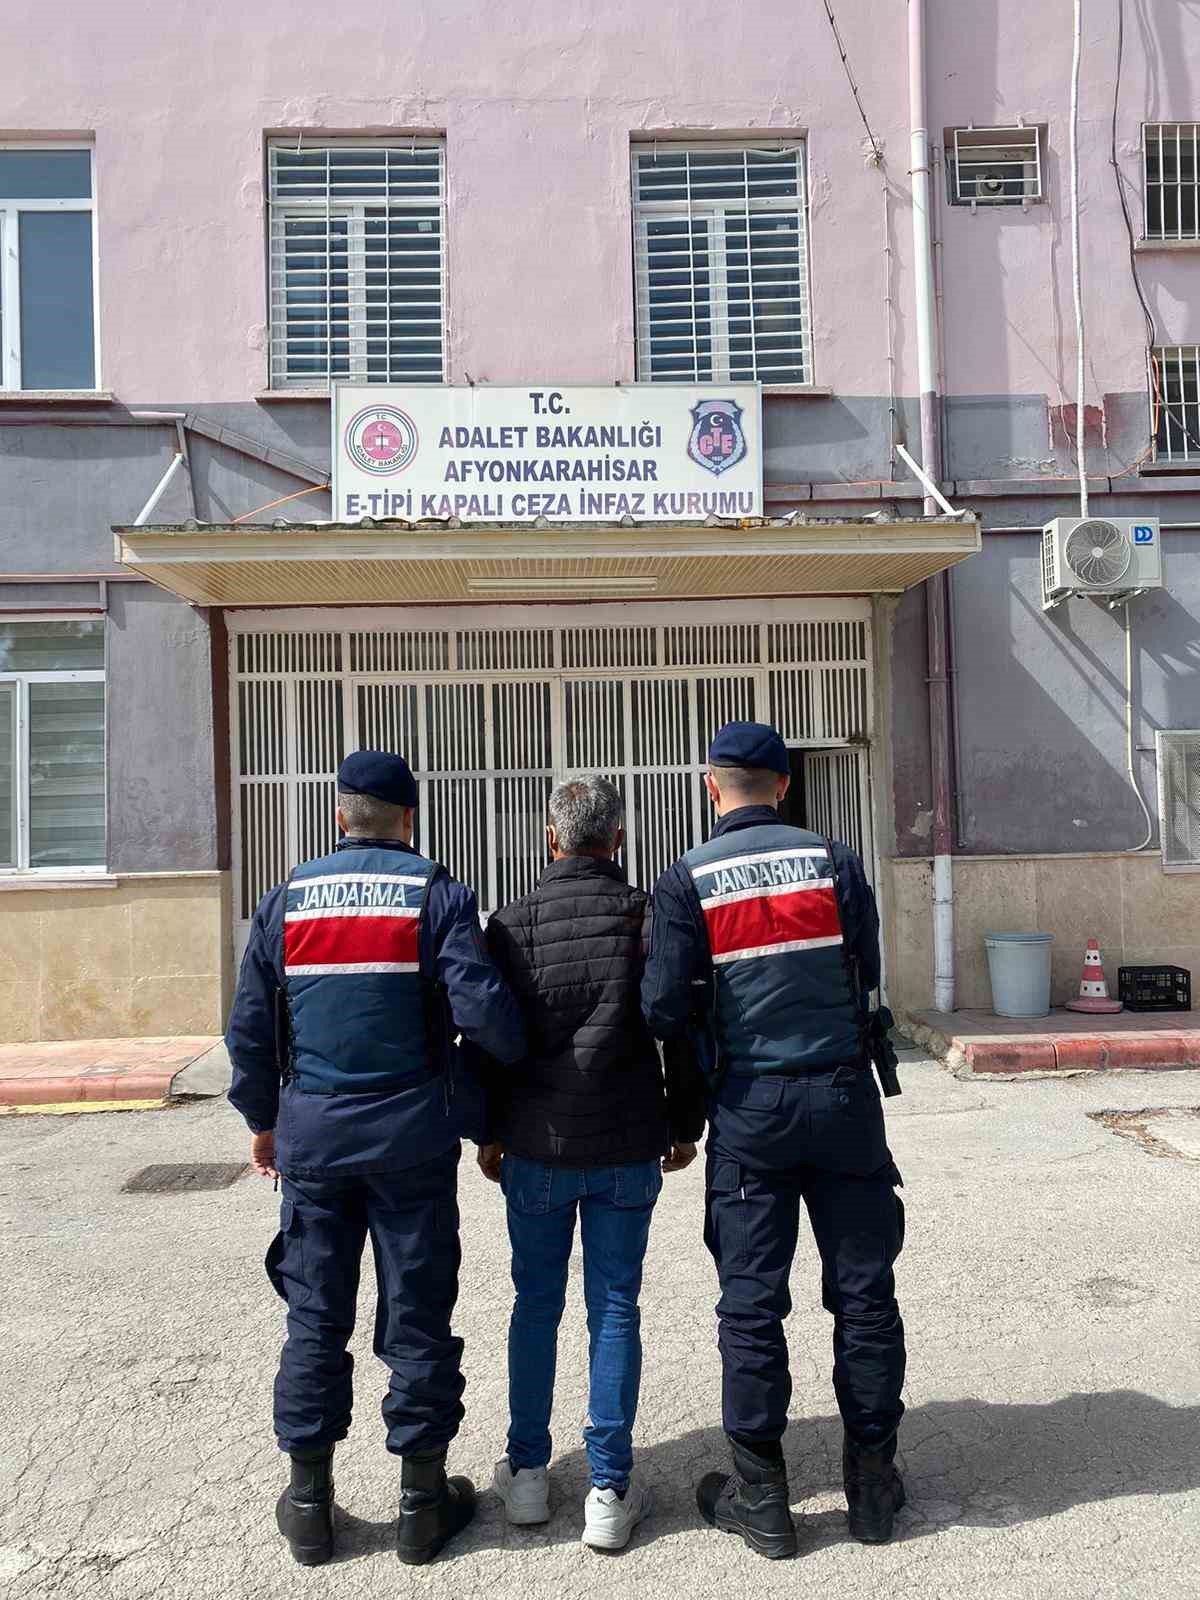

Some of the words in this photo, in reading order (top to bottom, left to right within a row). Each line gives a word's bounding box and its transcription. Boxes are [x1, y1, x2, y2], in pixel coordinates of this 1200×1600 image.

[529, 393, 570, 414] T.C.
[438, 426, 528, 448] ADALET
[537, 420, 661, 448] BAKANLIĞI
[444, 455, 658, 482] AFYONKARAHİSAR
[346, 488, 412, 516] E-TİPİ
[421, 494, 503, 516] KAPALI
[511, 493, 571, 516] CEZA
[579, 488, 645, 516] İNFAZ
[654, 492, 754, 515] KURUMU
[711, 857, 819, 896] JANDARMA
[297, 883, 407, 911] JANDARMA
